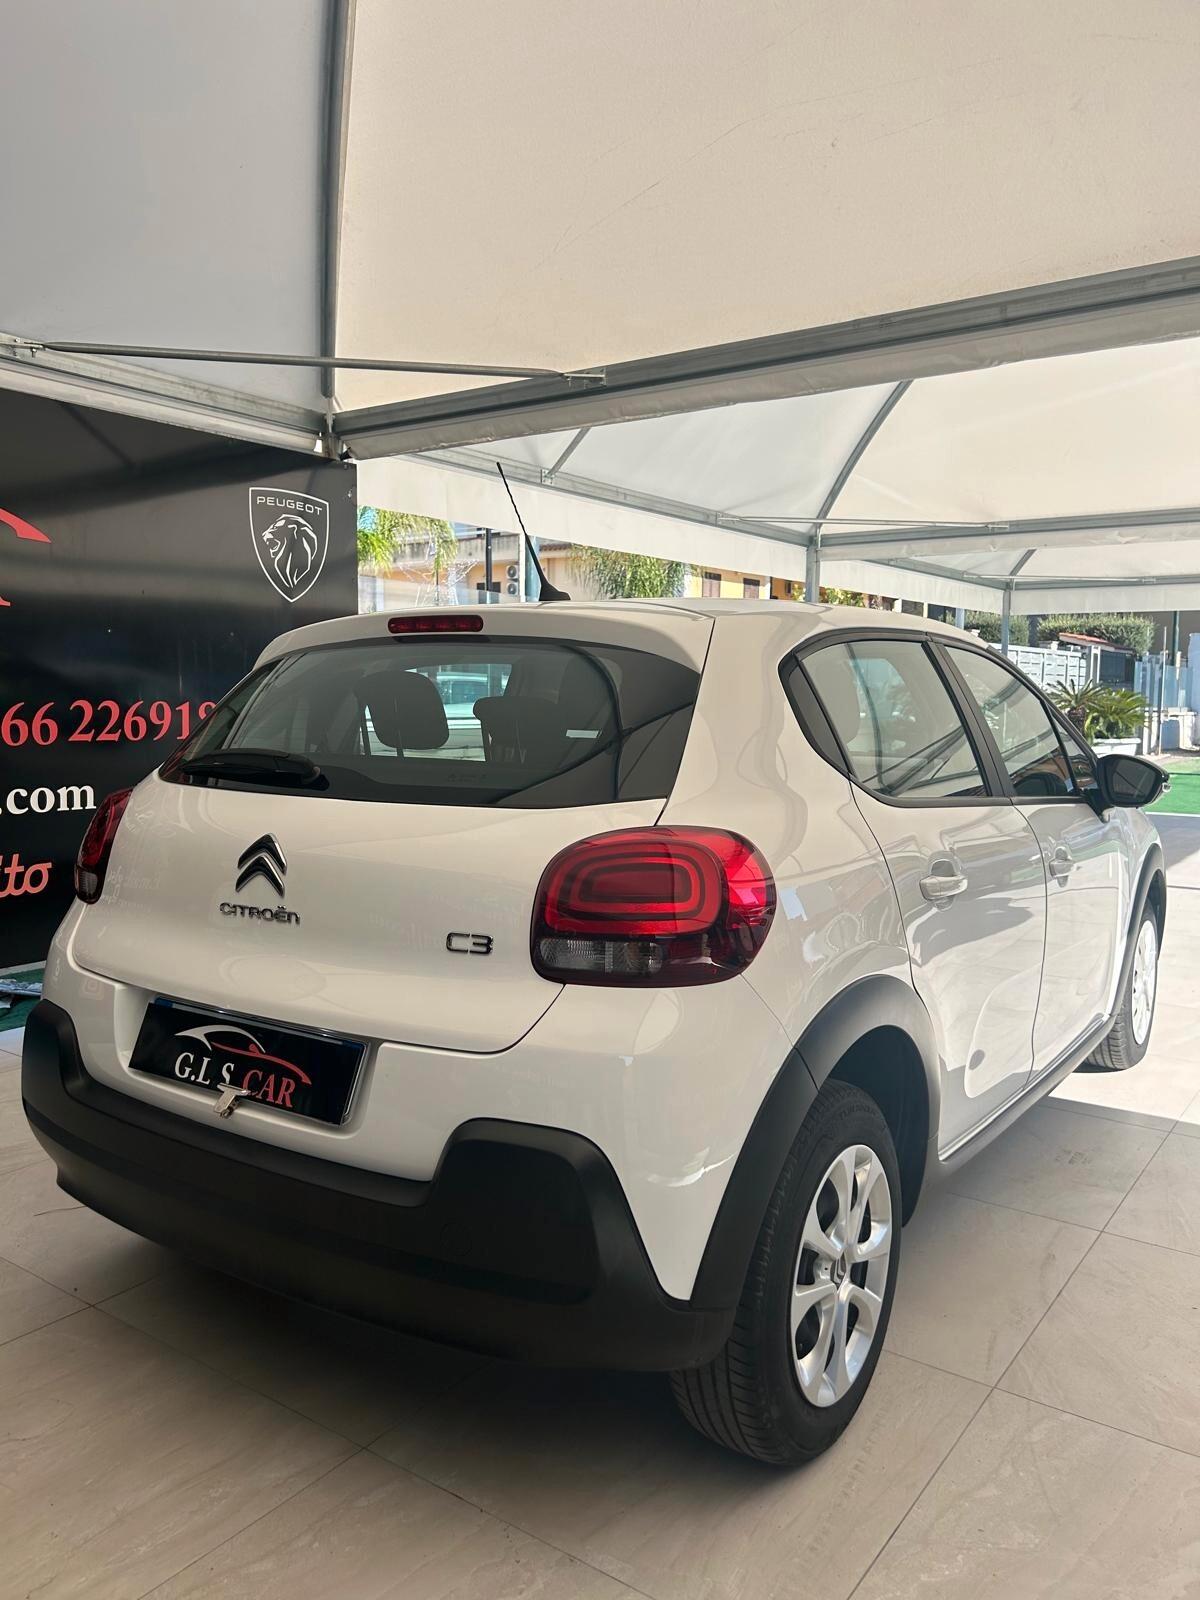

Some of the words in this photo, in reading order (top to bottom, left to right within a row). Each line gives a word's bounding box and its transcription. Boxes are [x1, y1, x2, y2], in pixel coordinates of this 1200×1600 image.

[256, 495, 324, 516] PEUGEOT
[1, 702, 58, 747] 66
[0, 782, 97, 816] com
[446, 932, 494, 955] C3
[242, 1069, 296, 1108] CAR
